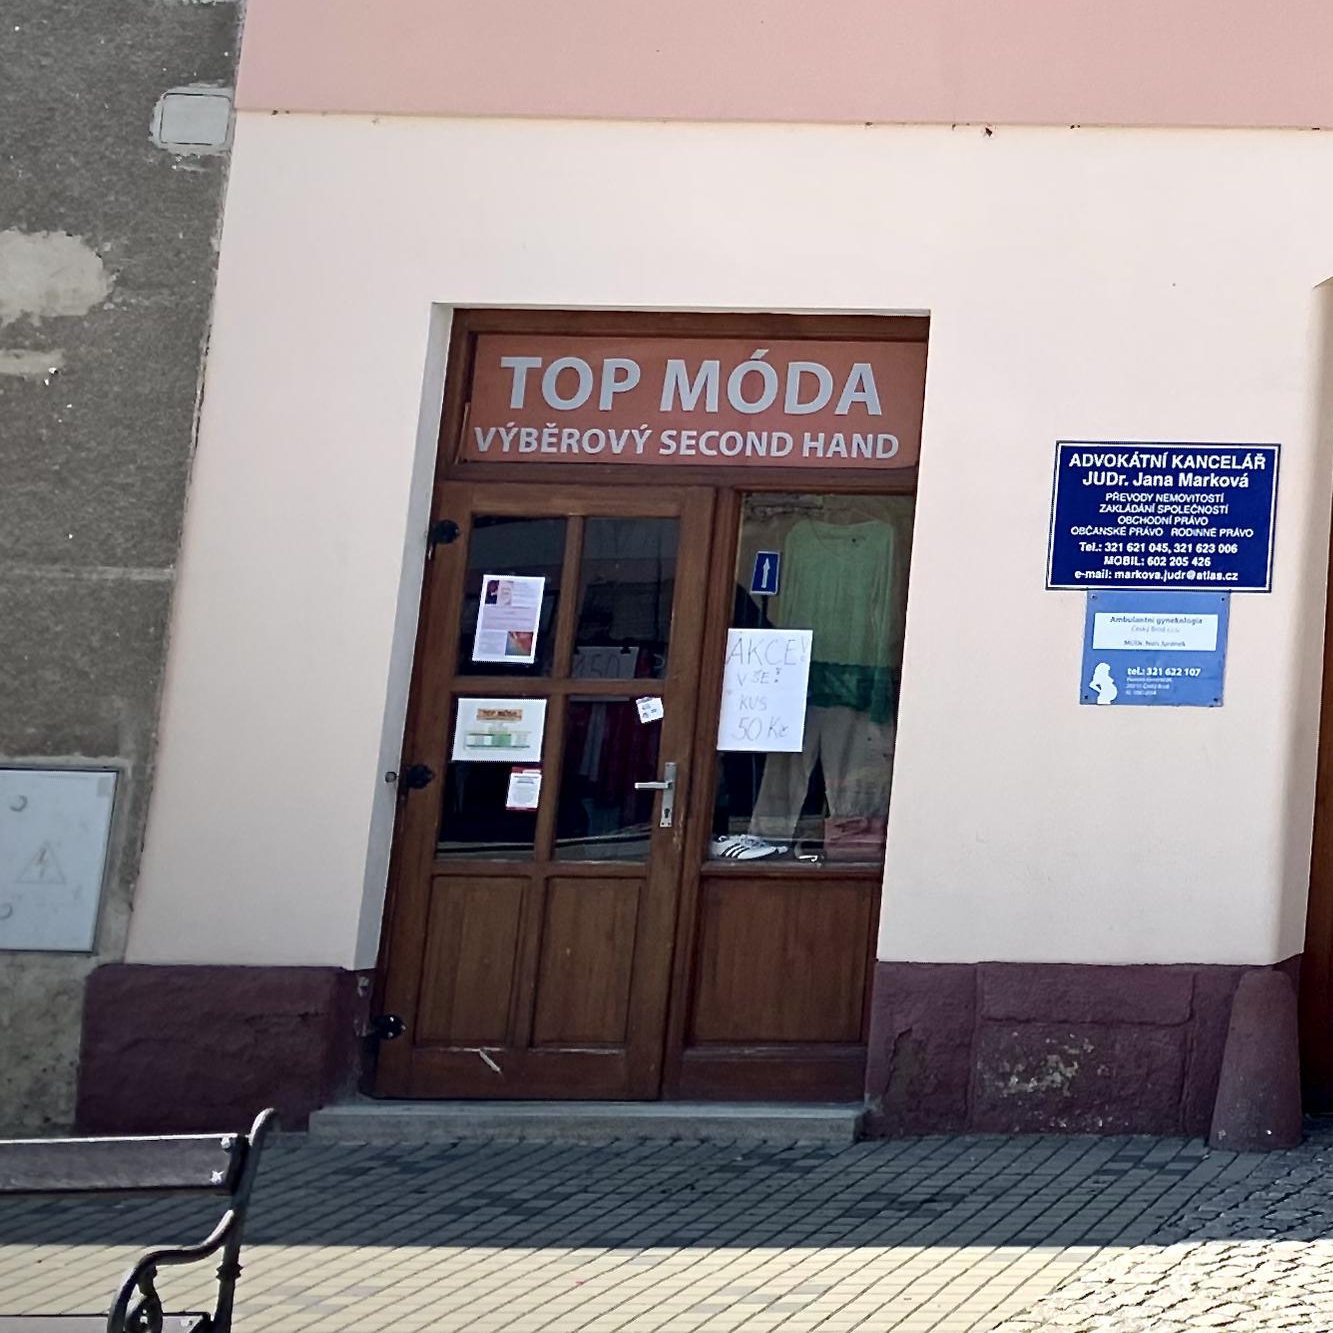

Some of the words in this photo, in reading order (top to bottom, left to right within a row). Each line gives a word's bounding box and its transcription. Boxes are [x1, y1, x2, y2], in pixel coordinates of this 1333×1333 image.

[500, 356, 641, 412] TOP
[659, 349, 883, 416] MÓDA
[473, 422, 653, 455] VÝBĚROVÝ
[658, 429, 795, 457] SECOND
[802, 432, 900, 460] HAND
[1069, 452, 1168, 469] ADVOKÁTNÍ
[1172, 453, 1266, 470] KANCELÁŘ
[1082, 471, 1129, 486] JUDr.
[1132, 472, 1174, 487] Jana
[1178, 473, 1249, 488] Marková
[1105, 491, 1154, 502] PŘEVODY
[1156, 492, 1224, 503] NEMOVITOSTÍ
[1099, 502, 1155, 514] ZAKLÁDÁNÍ
[1157, 503, 1229, 515] SPOLEČNOSTÍ
[1117, 514, 1173, 525] OBCHODNÍ
[1174, 515, 1208, 526] PRÁVO
[1071, 525, 1126, 536] OBČANSKÉ
[1129, 526, 1163, 537] PRÁVO
[1219, 528, 1254, 538] PRÁVO
[1079, 542, 1102, 552] Tel.:
[1105, 542, 1124, 553] 321
[1126, 542, 1146, 553] 621
[1148, 543, 1172, 555] 045,
[1173, 543, 1193, 554] 321
[1195, 543, 1216, 554] 623
[1218, 543, 1238, 554] 006
[1104, 556, 1145, 567] MOBIL:
[1147, 556, 1167, 567] 602
[1169, 557, 1189, 567] 205
[1191, 557, 1212, 567] 426
[1074, 569, 1113, 580] e-mail:
[1114, 570, 1239, 583] markova.judr@atlas.cz
[726, 636, 807, 665] AKCE!
[1146, 667, 1163, 676] 321
[1184, 668, 1201, 677] 107
[732, 717, 762, 741] 50
